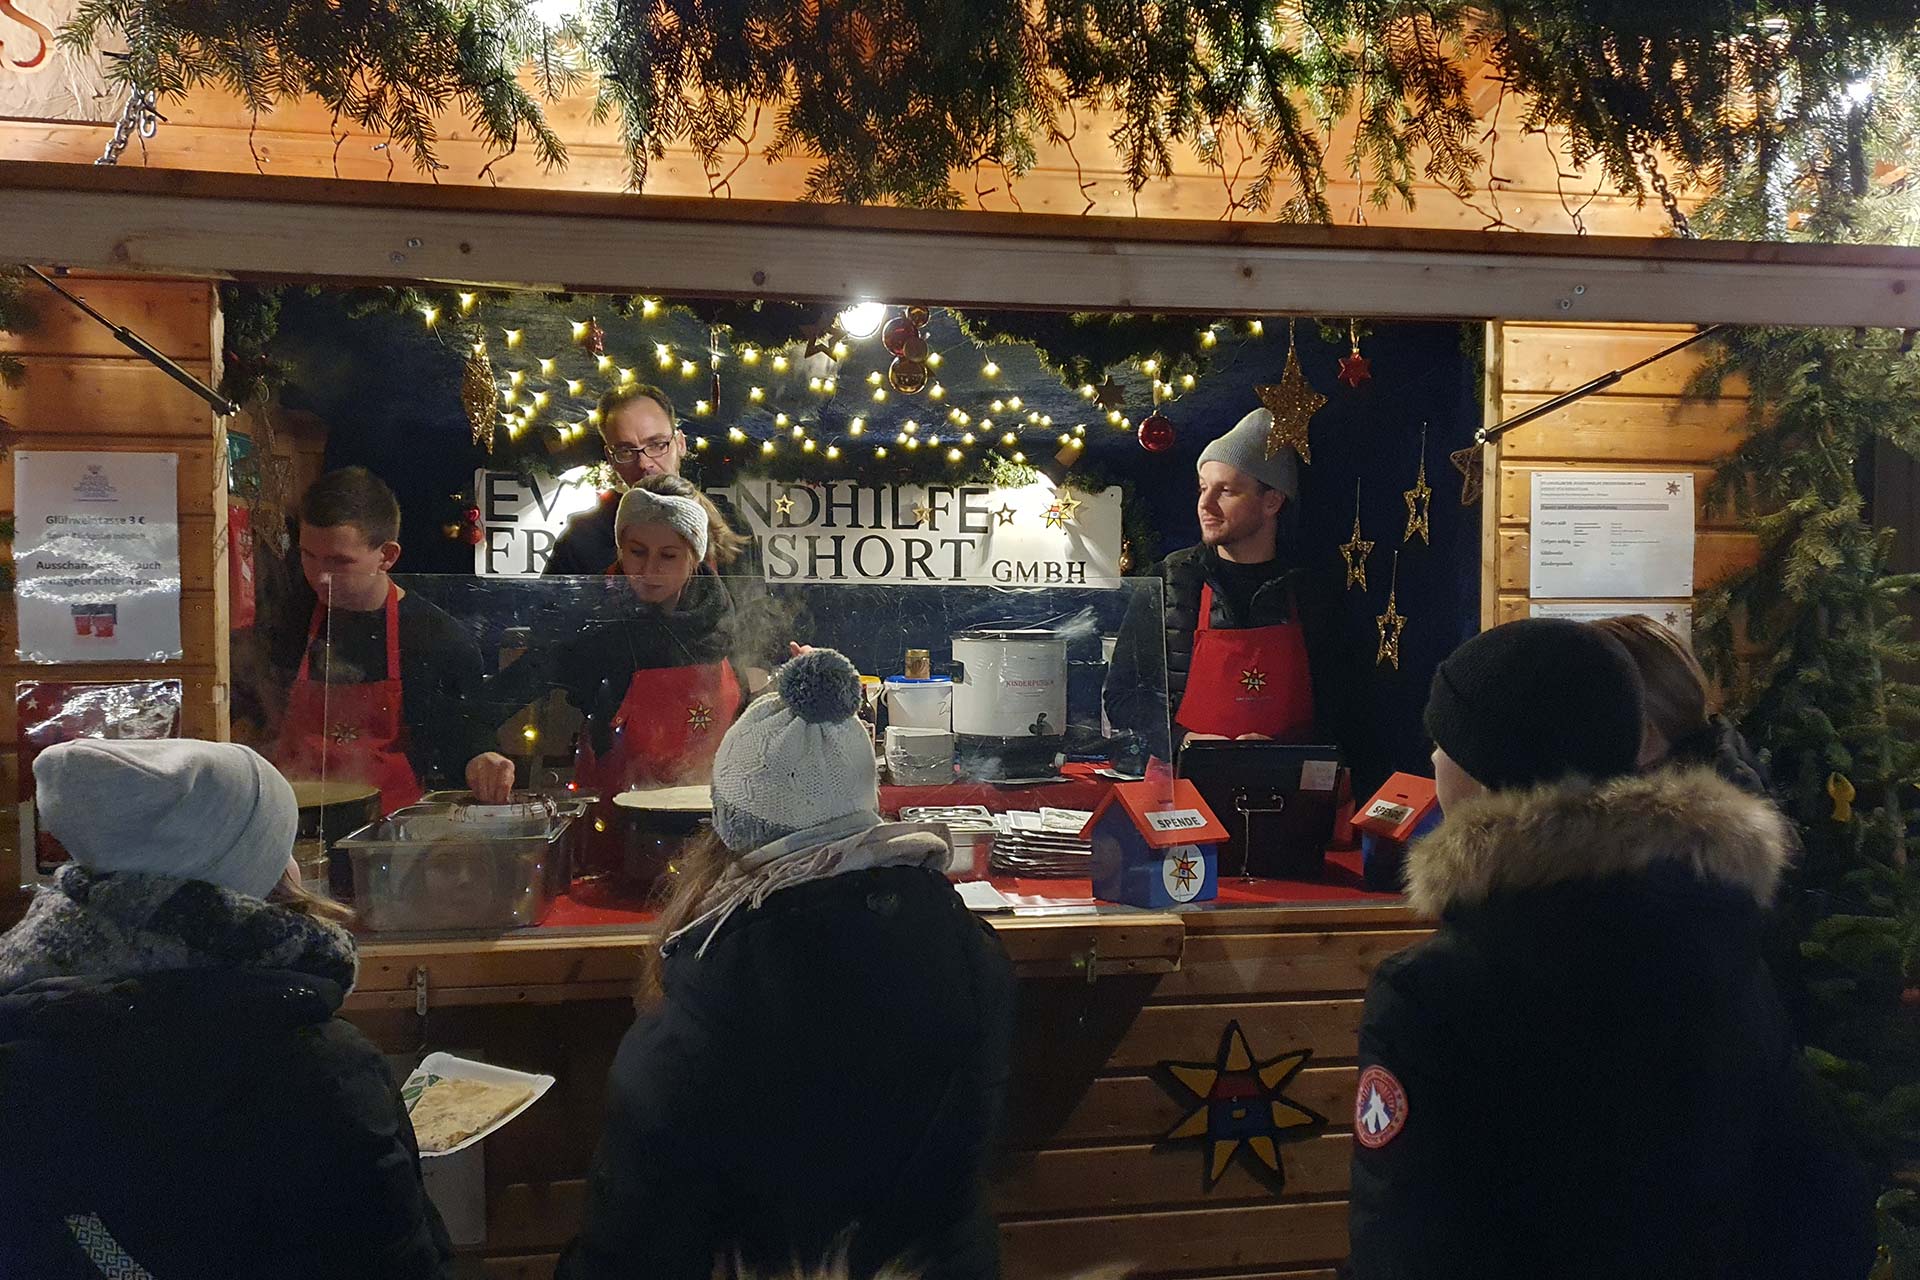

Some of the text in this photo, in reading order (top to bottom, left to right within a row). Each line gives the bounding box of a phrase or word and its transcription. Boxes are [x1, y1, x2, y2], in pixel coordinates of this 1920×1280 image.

[128, 516, 135, 525] 3
[991, 559, 1087, 584] GMBH
[1157, 816, 1200, 829] SPENDE
